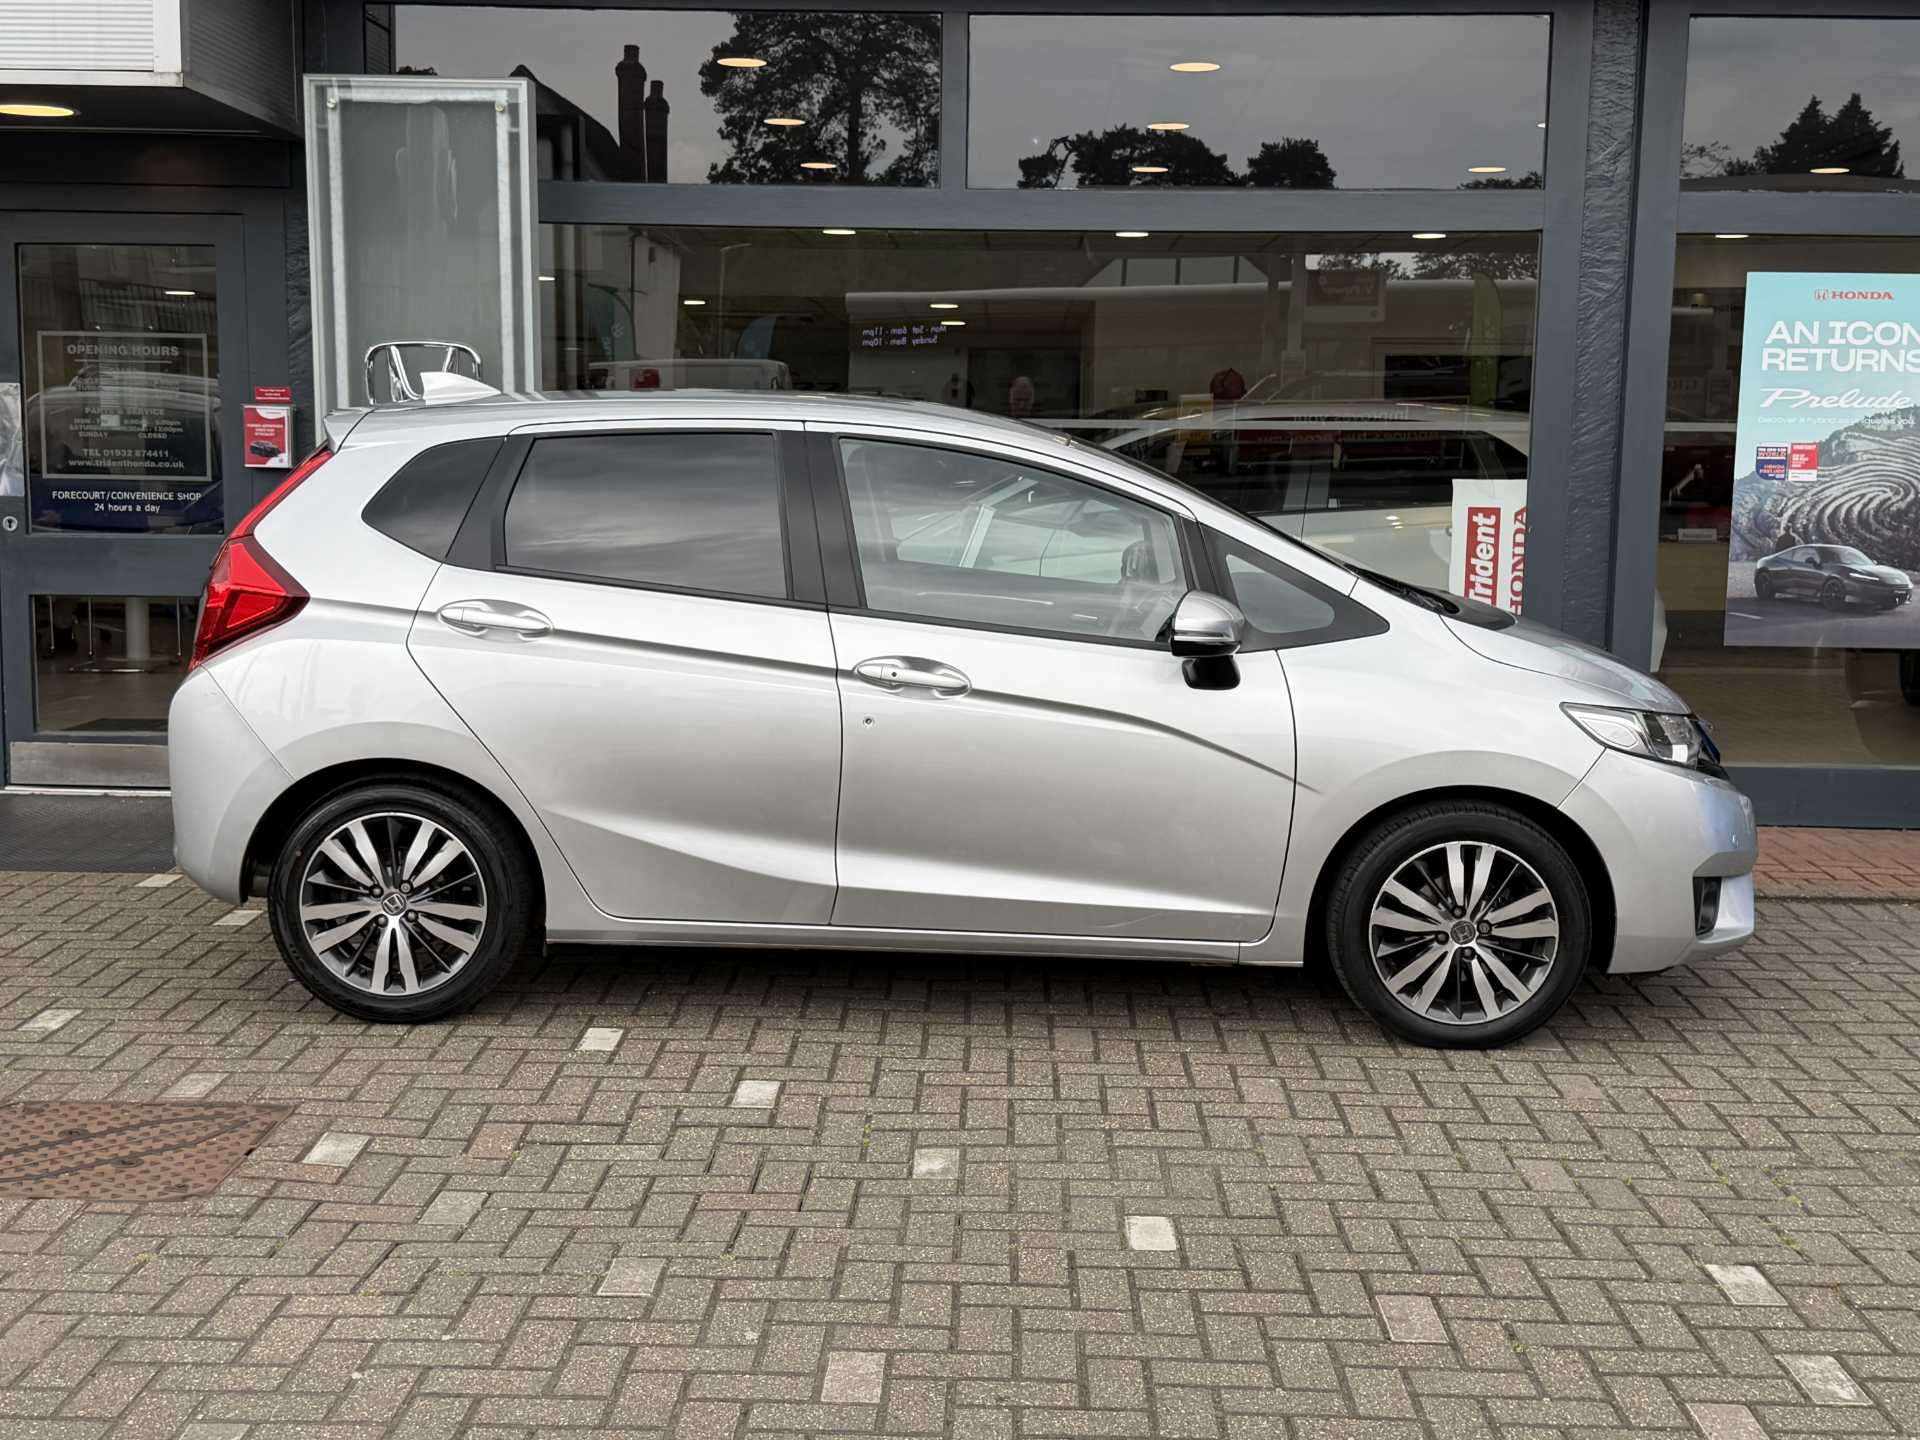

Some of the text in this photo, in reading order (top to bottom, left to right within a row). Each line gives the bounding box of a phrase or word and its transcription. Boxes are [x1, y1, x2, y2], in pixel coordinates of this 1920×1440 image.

[1831, 290, 1893, 300] HONDA
[1764, 320, 1920, 346] AN ICON
[67, 344, 179, 357] OPENING HOURS
[1761, 348, 1920, 373] RETURNS
[1760, 388, 1915, 409] Prelude
[83, 448, 101, 457] TEL
[103, 449, 133, 457] 01932
[52, 490, 202, 501] FORECOURT/CONVENIENCE SHOP
[94, 503, 161, 514] 24 hours a day
